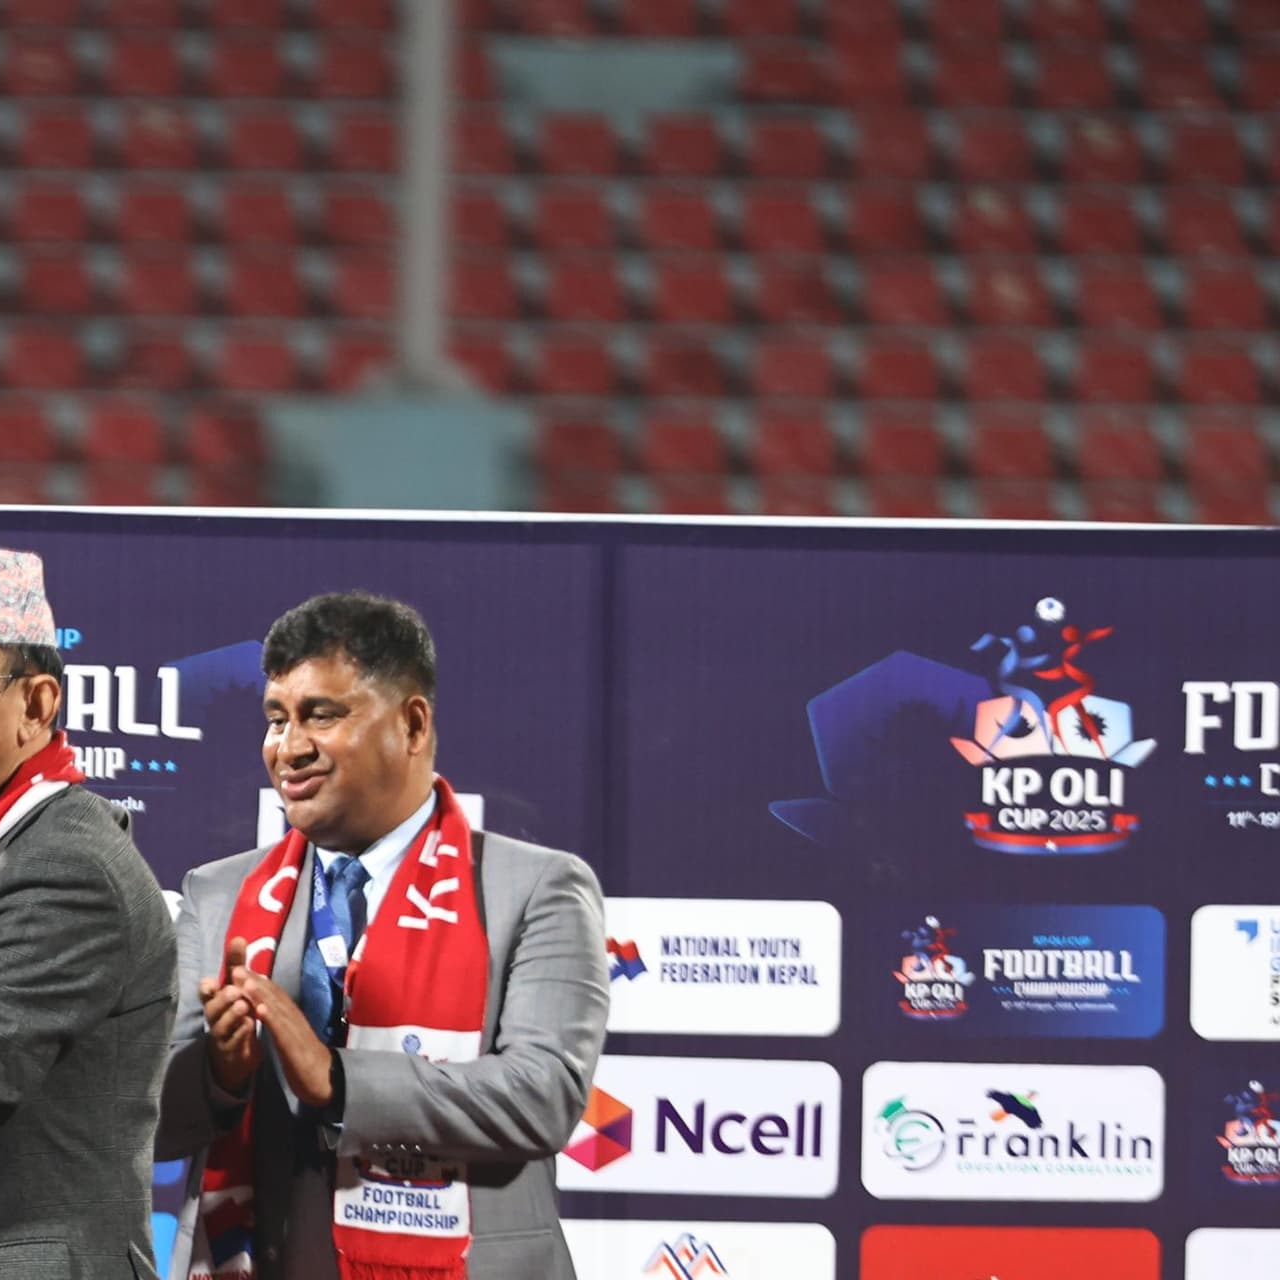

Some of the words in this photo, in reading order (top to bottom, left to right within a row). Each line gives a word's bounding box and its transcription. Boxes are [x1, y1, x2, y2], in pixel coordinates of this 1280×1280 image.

[980, 766, 1043, 807] KP
[1049, 767, 1125, 807] OLI
[997, 807, 1048, 832] CUP
[1048, 809, 1107, 832] 2025
[659, 935, 740, 958] NATIONAL
[747, 937, 802, 959] YOUTH
[659, 962, 760, 985] FEDERATION
[766, 963, 820, 987] NEPAL
[983, 948, 1142, 983] FOOTBALL
[655, 1096, 823, 1159] Ncell
[955, 1118, 1155, 1160] Franklin
[362, 1186, 442, 1210] FOOTBALL
[343, 1203, 460, 1231] CHAMPIONSHIP
